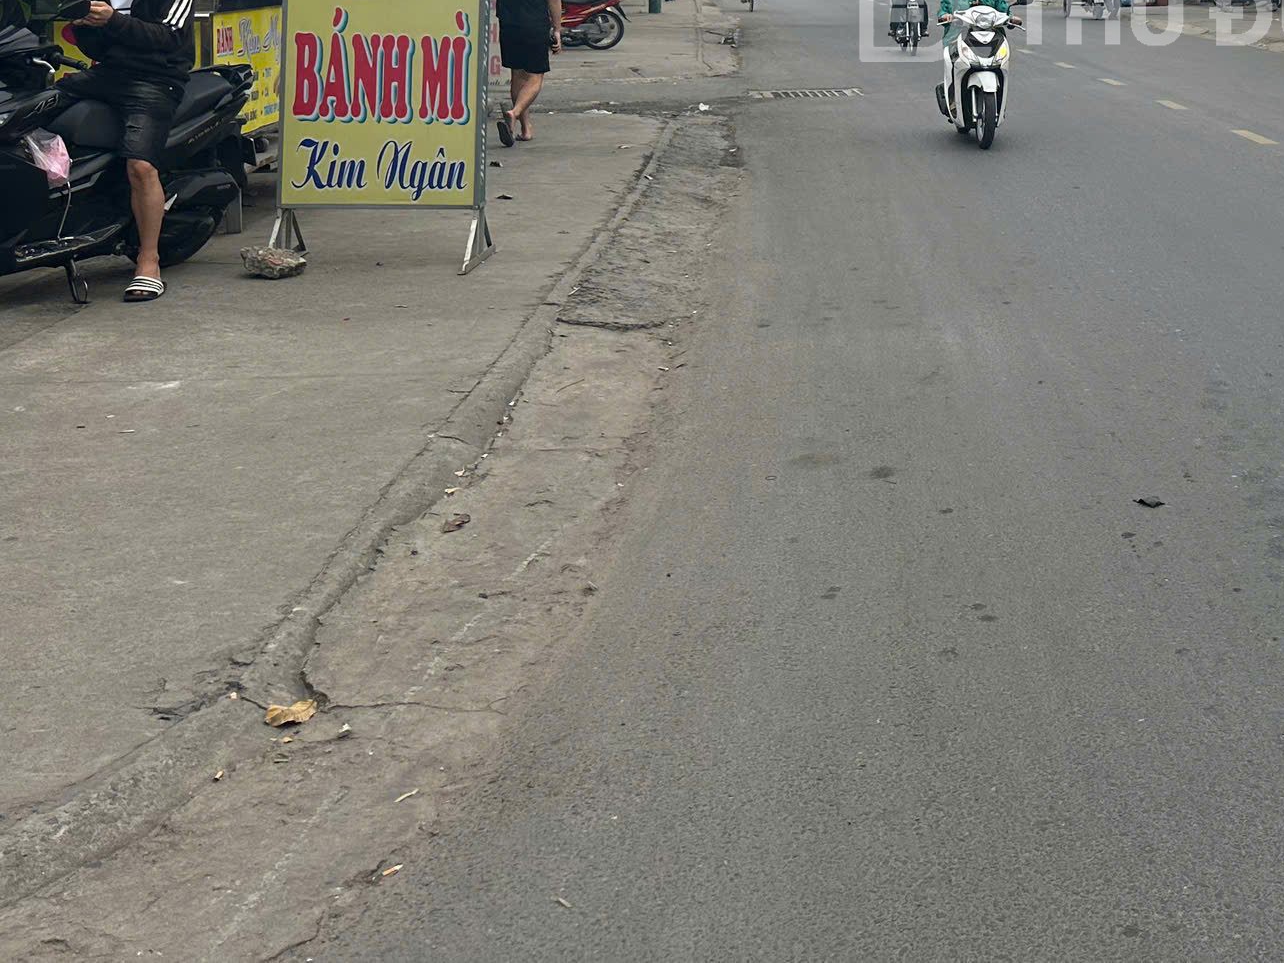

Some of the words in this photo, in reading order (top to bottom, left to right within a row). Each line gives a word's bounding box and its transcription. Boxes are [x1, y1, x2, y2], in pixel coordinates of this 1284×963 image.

[291, 6, 416, 125] BÁNH
[418, 10, 473, 126] MÌ
[290, 137, 368, 191] Kim
[376, 139, 468, 201] Ngân
